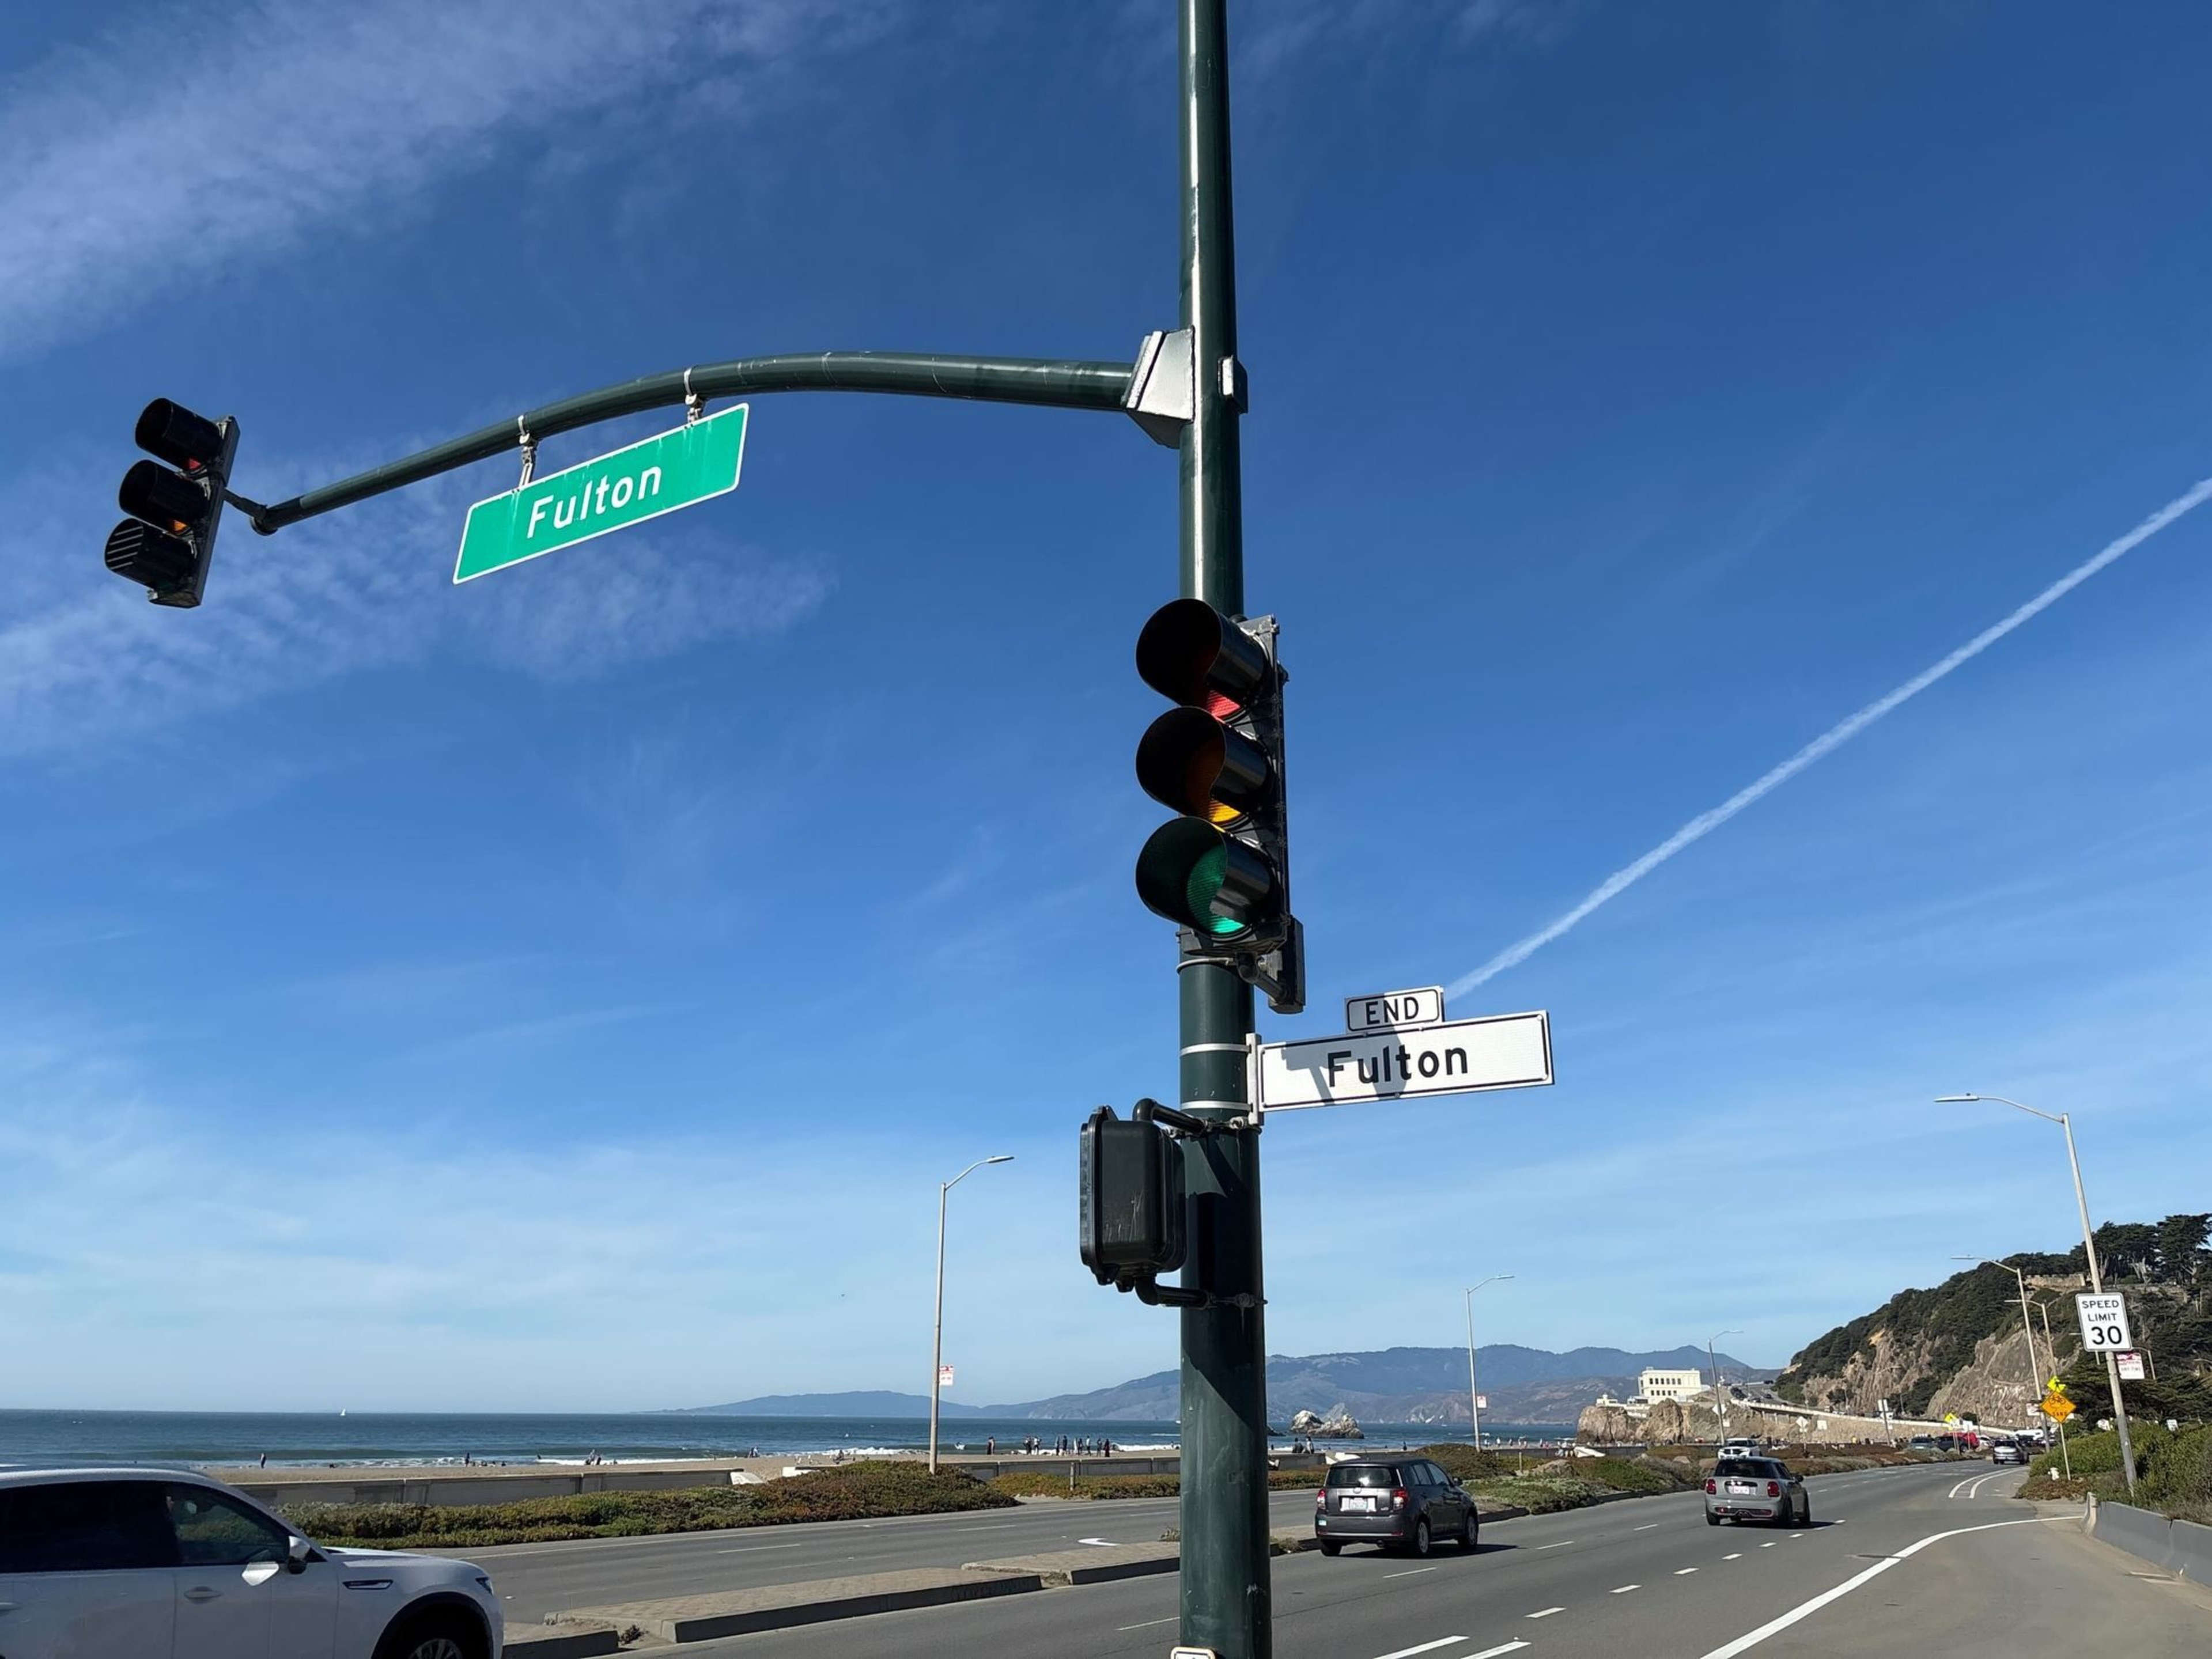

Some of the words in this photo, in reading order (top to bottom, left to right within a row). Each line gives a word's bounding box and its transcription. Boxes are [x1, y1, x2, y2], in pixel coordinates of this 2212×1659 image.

[527, 466, 662, 538] Fulton
[1366, 997, 1419, 1025] END
[1328, 1044, 1468, 1087] Fulton
[2082, 1300, 2119, 1309] SPEED
[2088, 1313, 2117, 1321] LIMIT
[2091, 1325, 2122, 1345] 30
